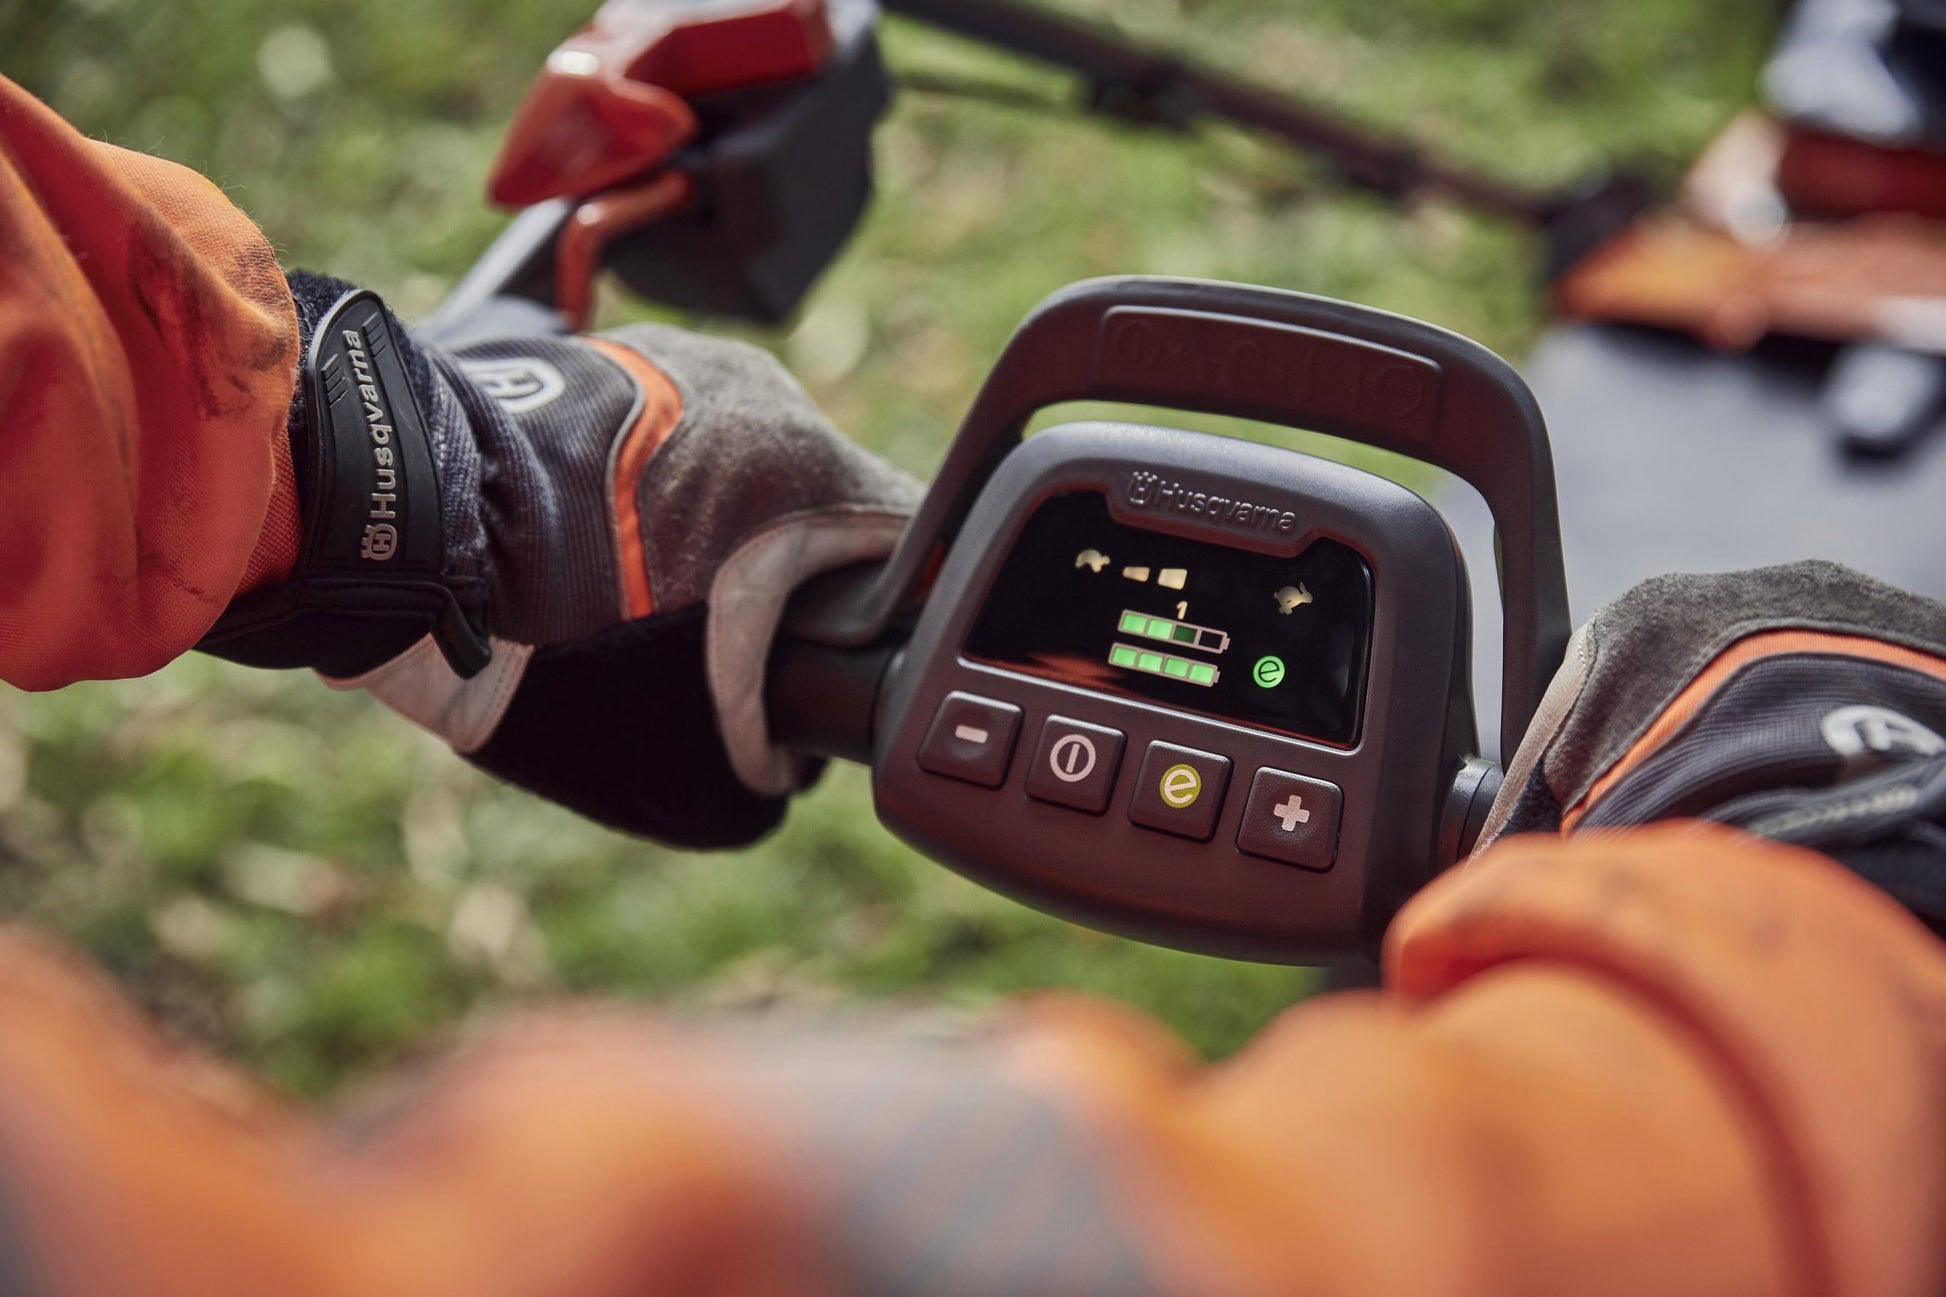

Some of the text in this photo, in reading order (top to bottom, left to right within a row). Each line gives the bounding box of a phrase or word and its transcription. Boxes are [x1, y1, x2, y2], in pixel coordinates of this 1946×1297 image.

[342, 329, 397, 519] Husqvarna
[1154, 480, 1297, 530] Husqvarna
[1175, 600, 1189, 620] 1
[1164, 768, 1198, 804] e
